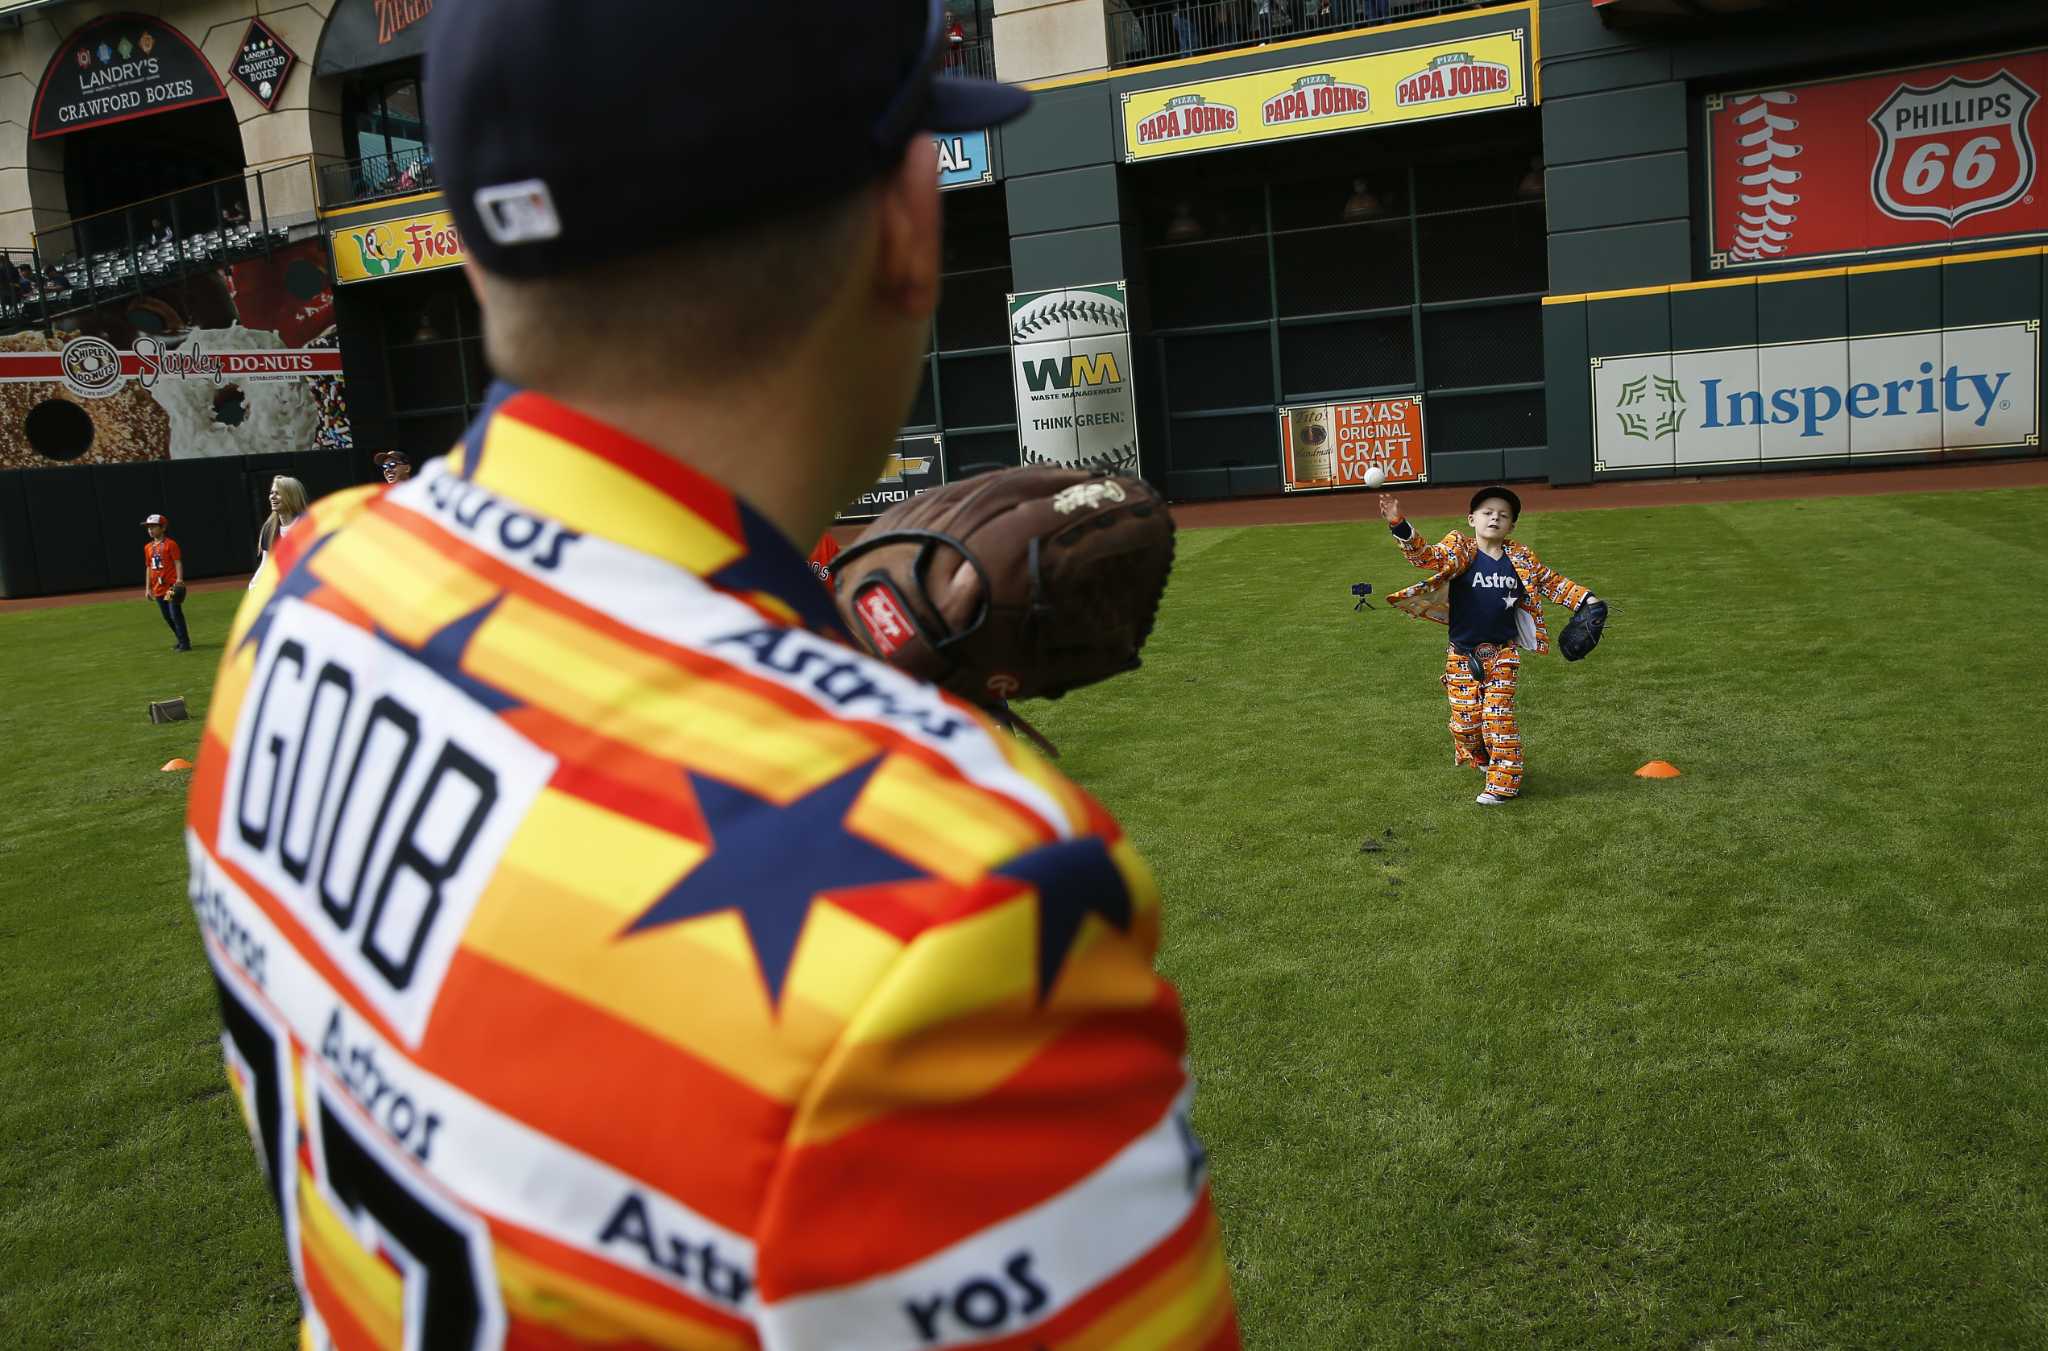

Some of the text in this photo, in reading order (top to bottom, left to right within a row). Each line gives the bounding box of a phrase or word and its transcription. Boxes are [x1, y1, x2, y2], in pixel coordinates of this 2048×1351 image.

[80, 58, 160, 90] LANDRY'S
[238, 56, 286, 75] CRAWFORD
[250, 68, 277, 82] BOXES
[1436, 54, 1464, 65] PIZZA
[1301, 75, 1327, 86] PIZZA
[1399, 71, 1445, 104] PAPA
[59, 91, 140, 122] CRAWFORD
[145, 79, 193, 103] BOXES
[1172, 95, 1198, 105] PIZZA
[1265, 91, 1308, 123] PAPA
[1896, 93, 2012, 132] PHILLIPS
[1140, 111, 1180, 142] PAPA
[931, 136, 972, 175] AL
[1902, 136, 2001, 195] 66
[404, 223, 464, 265] Fies
[68, 348, 108, 364] SHIPLEY
[133, 337, 314, 388] Shipley DO-NUTS
[1022, 352, 1121, 392] WM
[1031, 387, 1122, 402] WASTE MANAGEMENT
[1699, 361, 2011, 437] Insperity
[1033, 416, 1073, 430] THINK
[1340, 423, 1411, 440] ORIGINAL
[1341, 438, 1411, 461] CRAFT
[238, 638, 499, 992] GOOB
[321, 1005, 441, 1162] Astros
